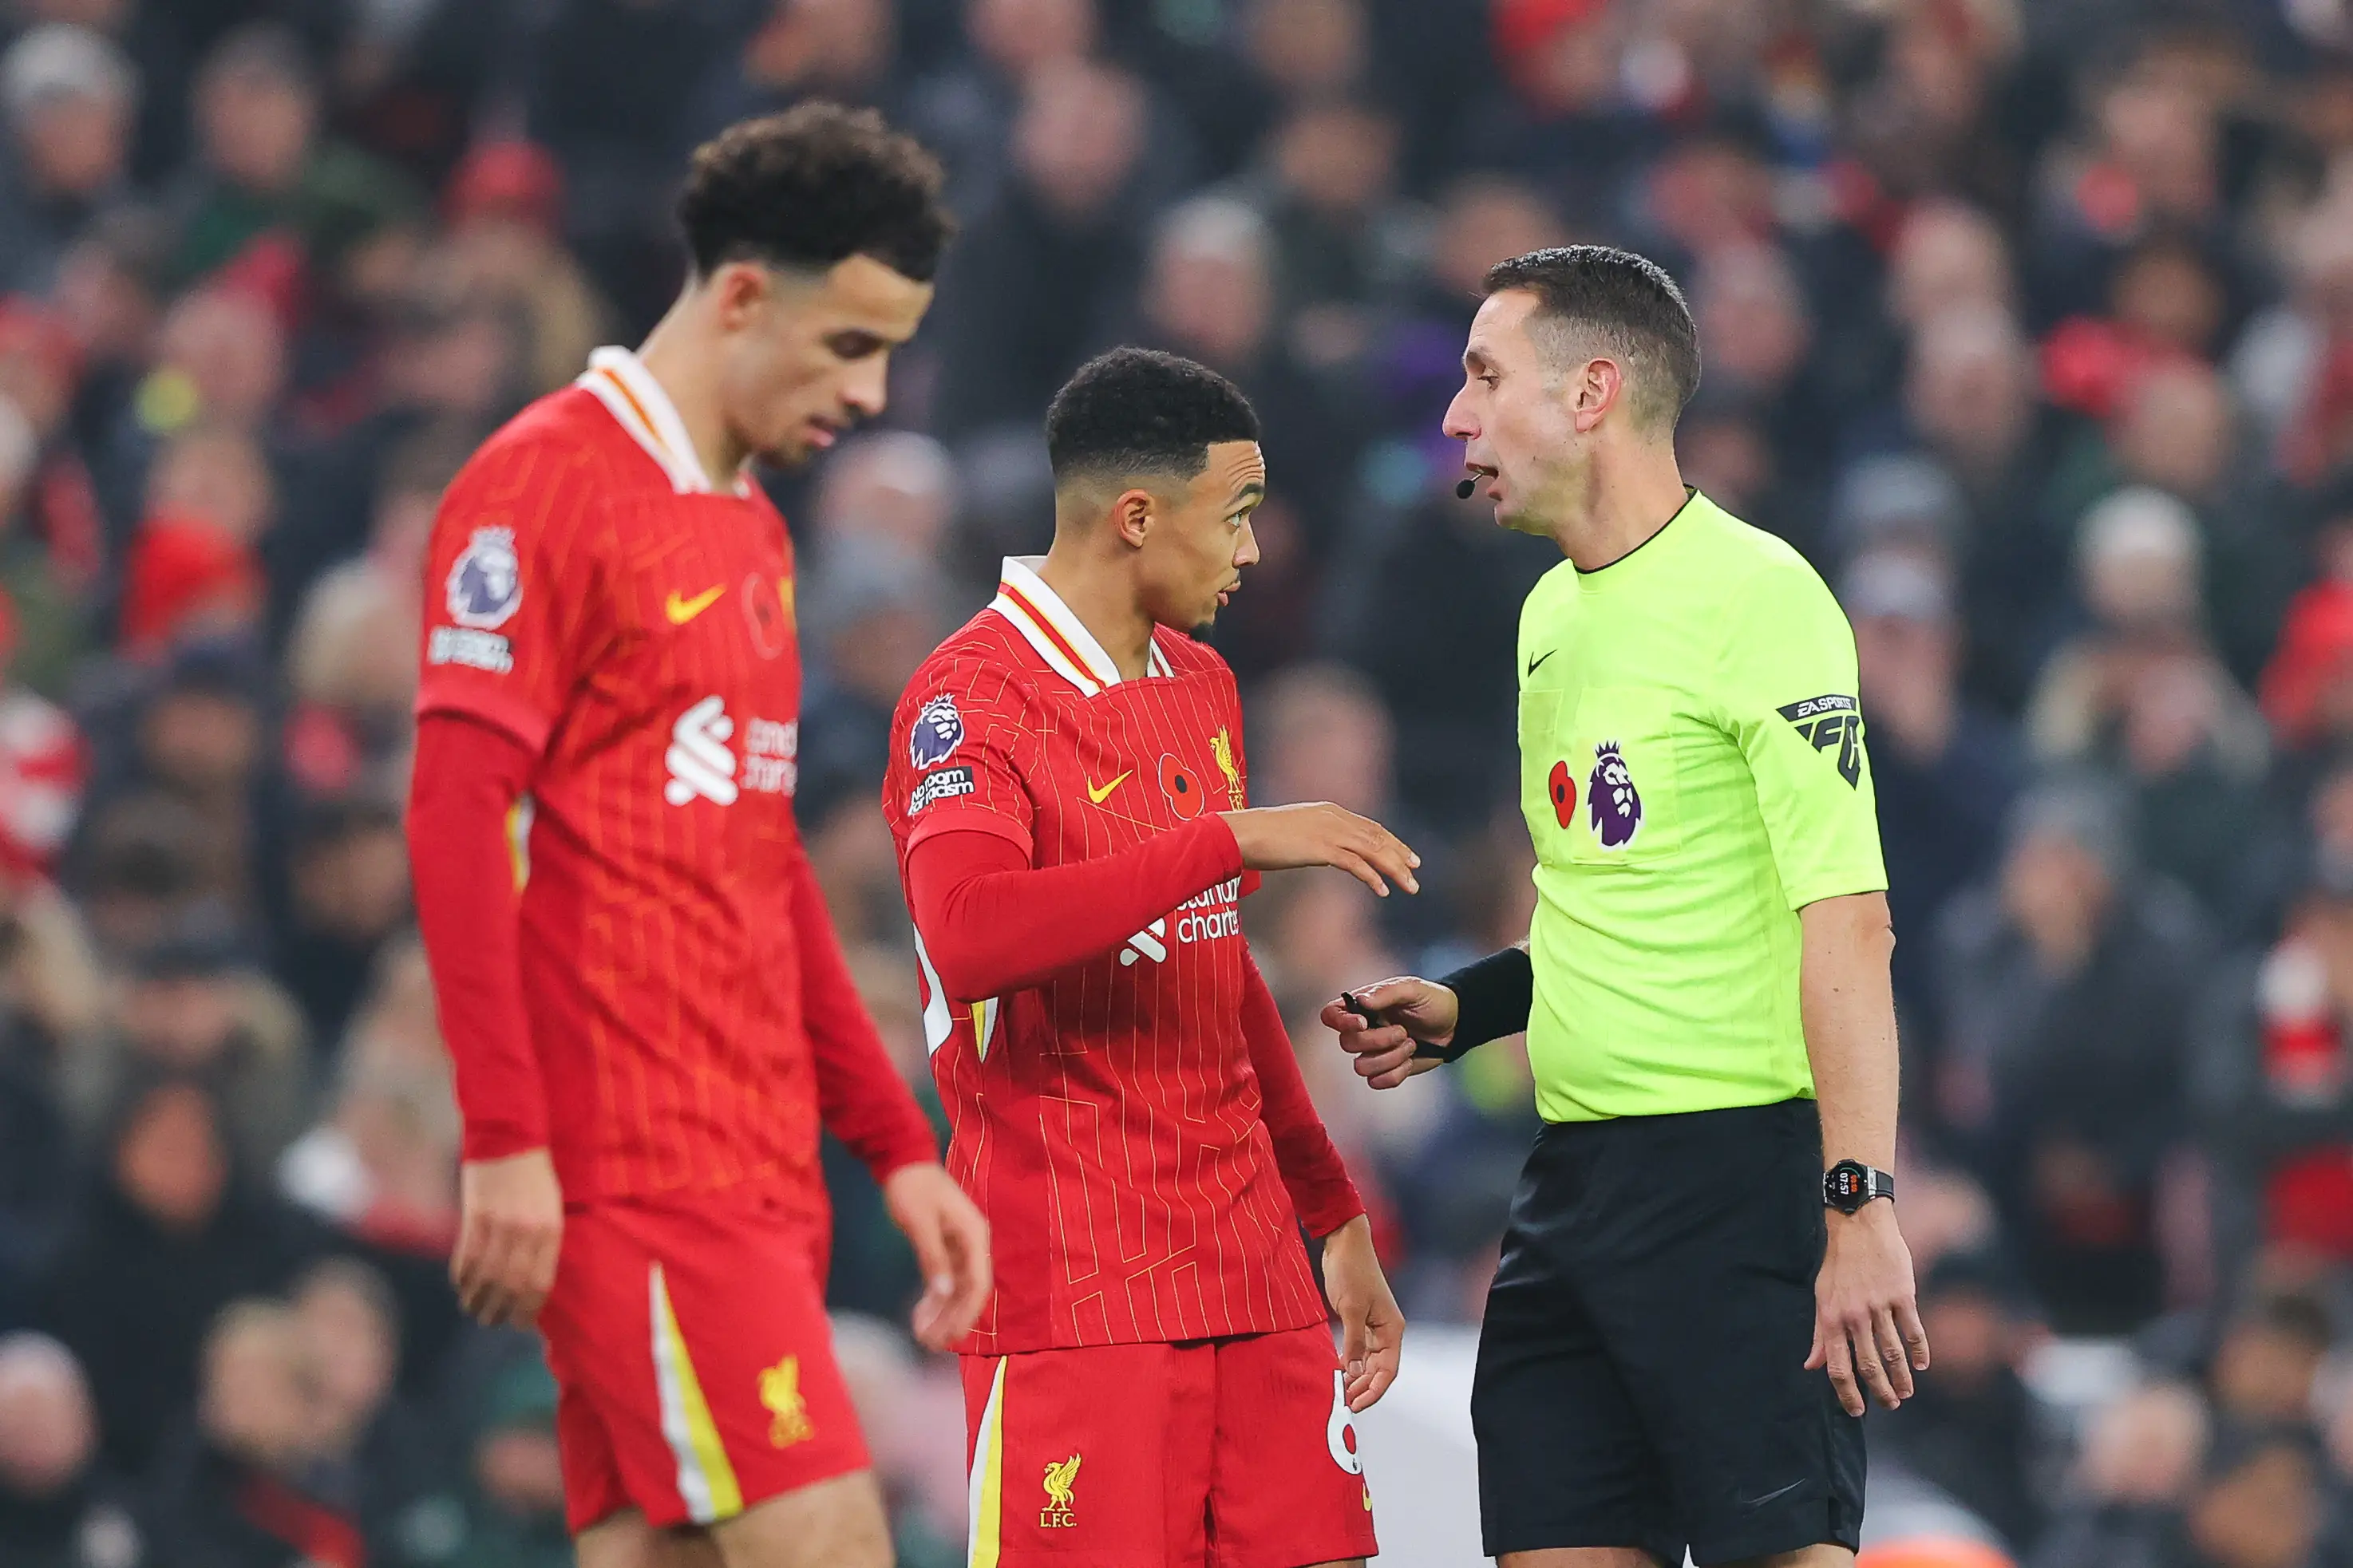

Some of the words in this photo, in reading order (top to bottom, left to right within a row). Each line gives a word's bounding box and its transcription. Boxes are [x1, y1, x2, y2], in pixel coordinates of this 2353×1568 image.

[1797, 701, 1821, 717] EA
[1817, 696, 1852, 710] SPORTS
[911, 784, 925, 803] No
[924, 769, 965, 792] room
[926, 781, 975, 805] racism
[1840, 1172, 1849, 1195] 07:57
[1040, 1512, 1078, 1528] L.F.C.
